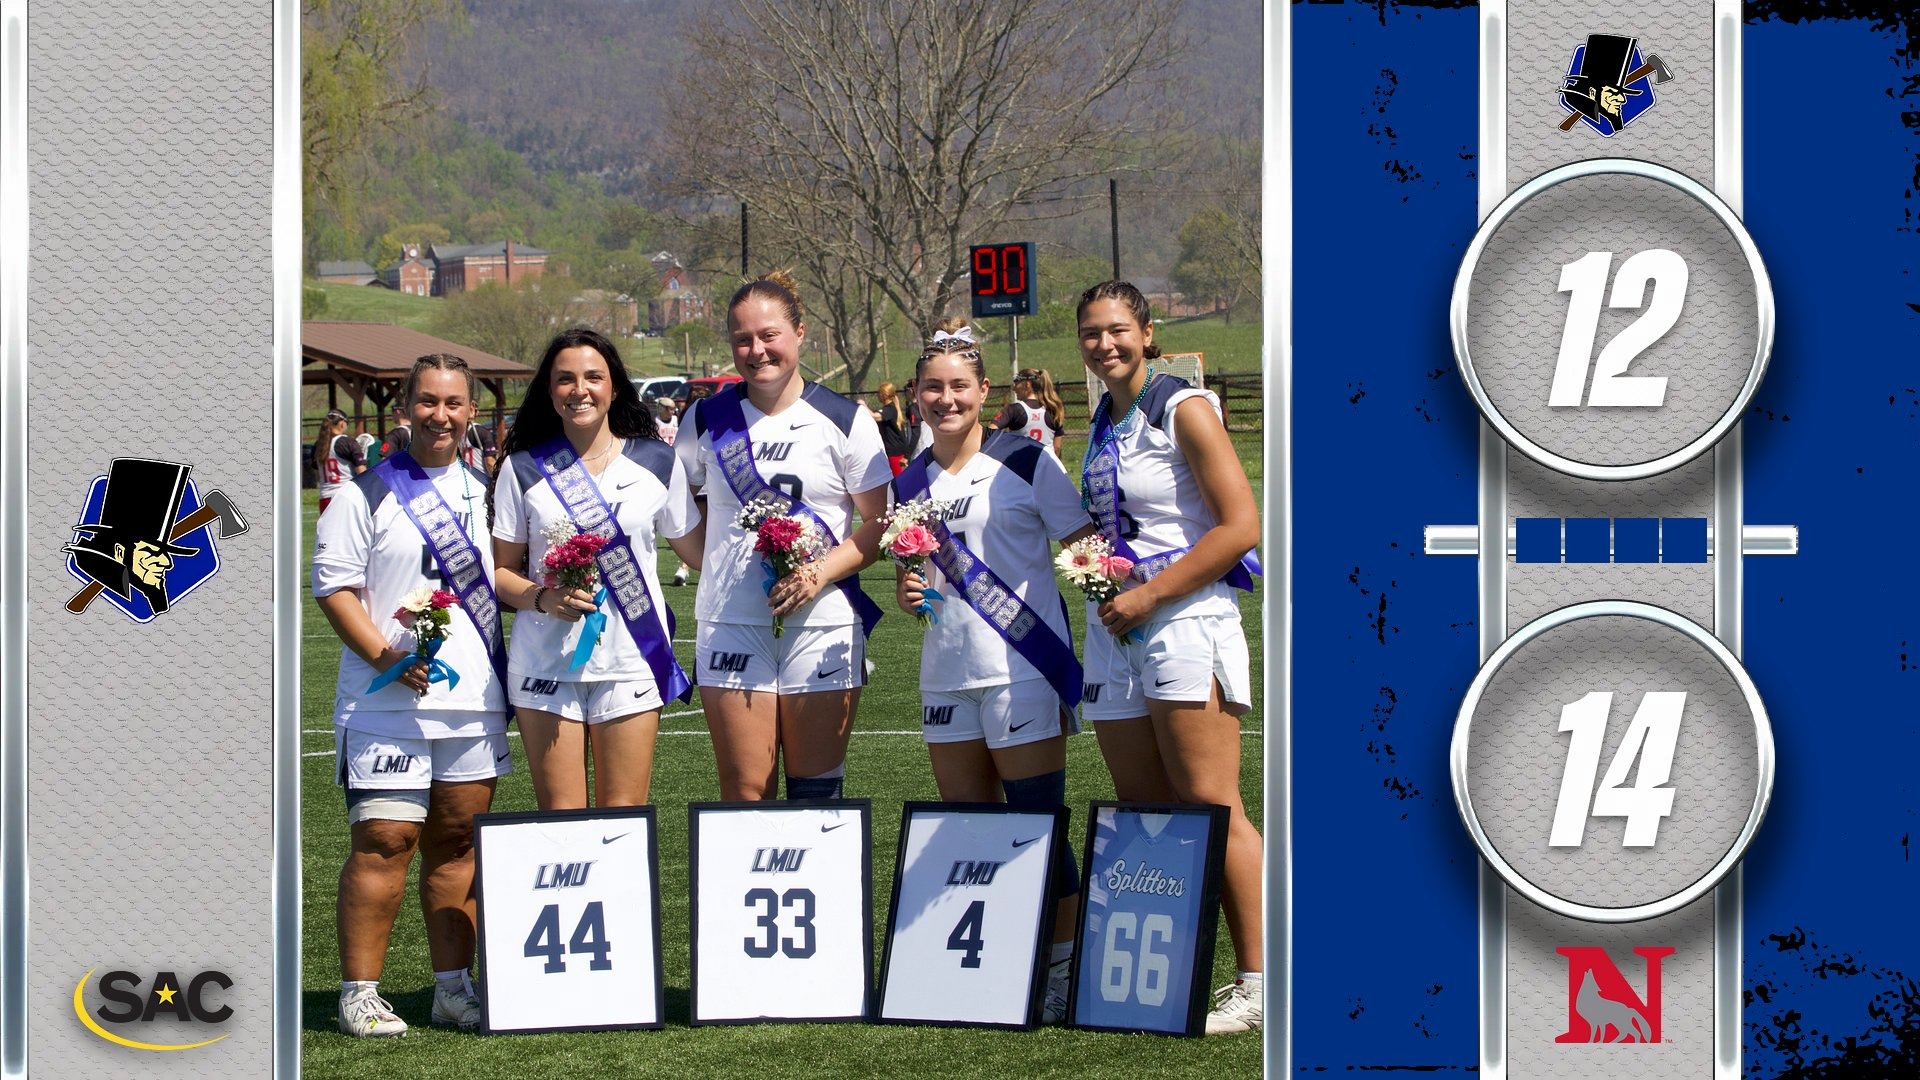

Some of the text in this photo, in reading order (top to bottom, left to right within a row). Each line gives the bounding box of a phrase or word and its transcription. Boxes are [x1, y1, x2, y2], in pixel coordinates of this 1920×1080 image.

[974, 246, 1025, 295] 90
[750, 440, 794, 462] MU
[1087, 453, 1118, 552] SENIO
[409, 490, 482, 593] SENIOR
[597, 544, 651, 622] 2026
[965, 571, 1037, 642] 2026
[710, 651, 754, 673] LMU
[520, 677, 559, 695] LMU
[1083, 682, 1106, 704] MU
[923, 704, 957, 727] LMU
[372, 754, 415, 775] LMU
[532, 859, 598, 891] LMU
[749, 847, 812, 876] LMU
[944, 860, 1006, 888] LMU
[1107, 859, 1185, 899] Splitters
[523, 901, 612, 974] 44
[744, 888, 816, 959] 33
[946, 901, 985, 968] 4
[1100, 912, 1173, 1007] 66
